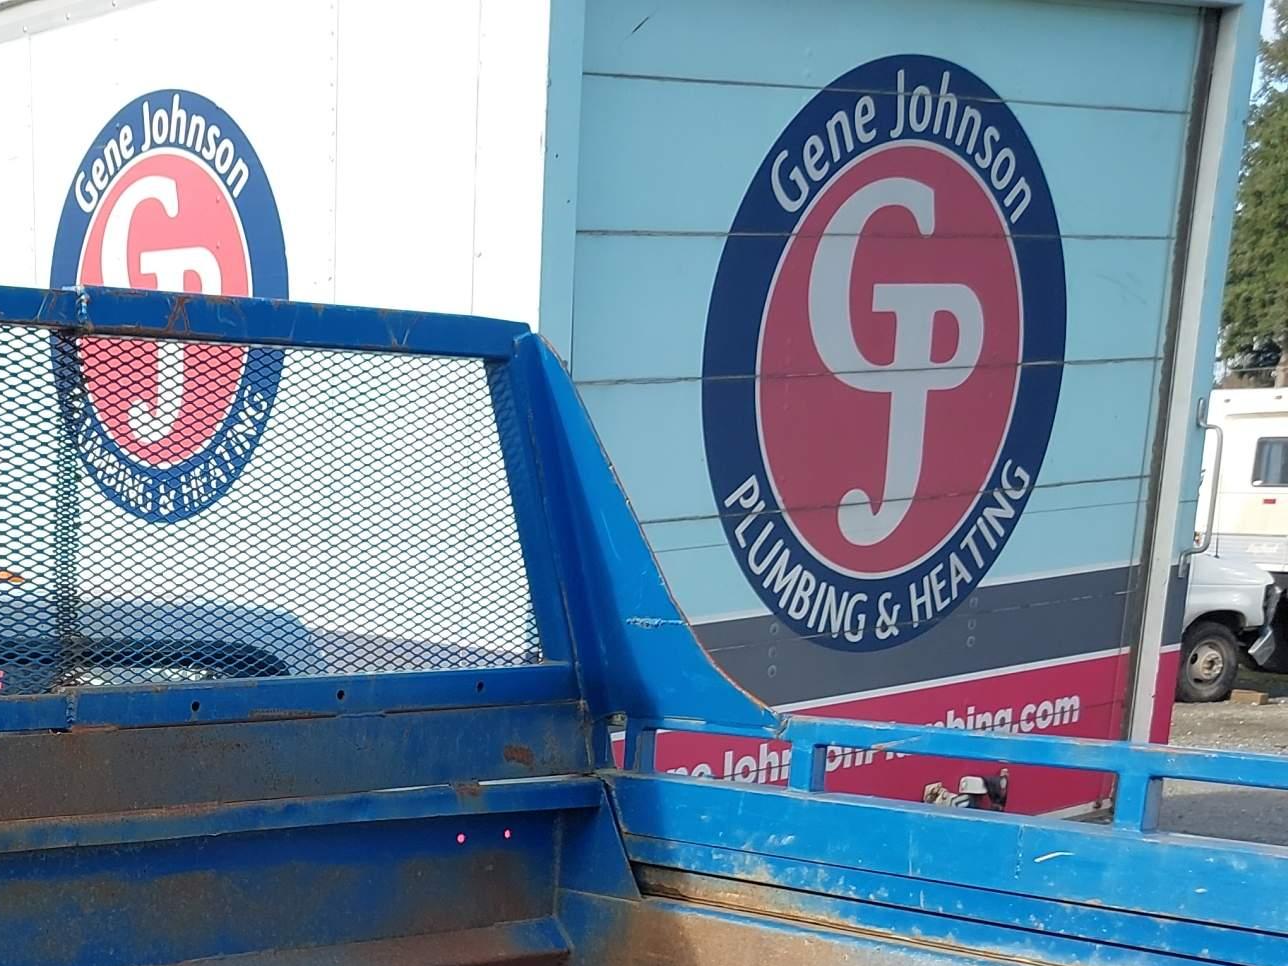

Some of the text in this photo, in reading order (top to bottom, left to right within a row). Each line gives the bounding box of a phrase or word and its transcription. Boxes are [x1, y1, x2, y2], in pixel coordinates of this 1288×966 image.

[75, 94, 249, 213] Gene Johnson
[771, 69, 1033, 224] Gene Johnson
[724, 458, 1031, 643] PLUMBING & HEATING
